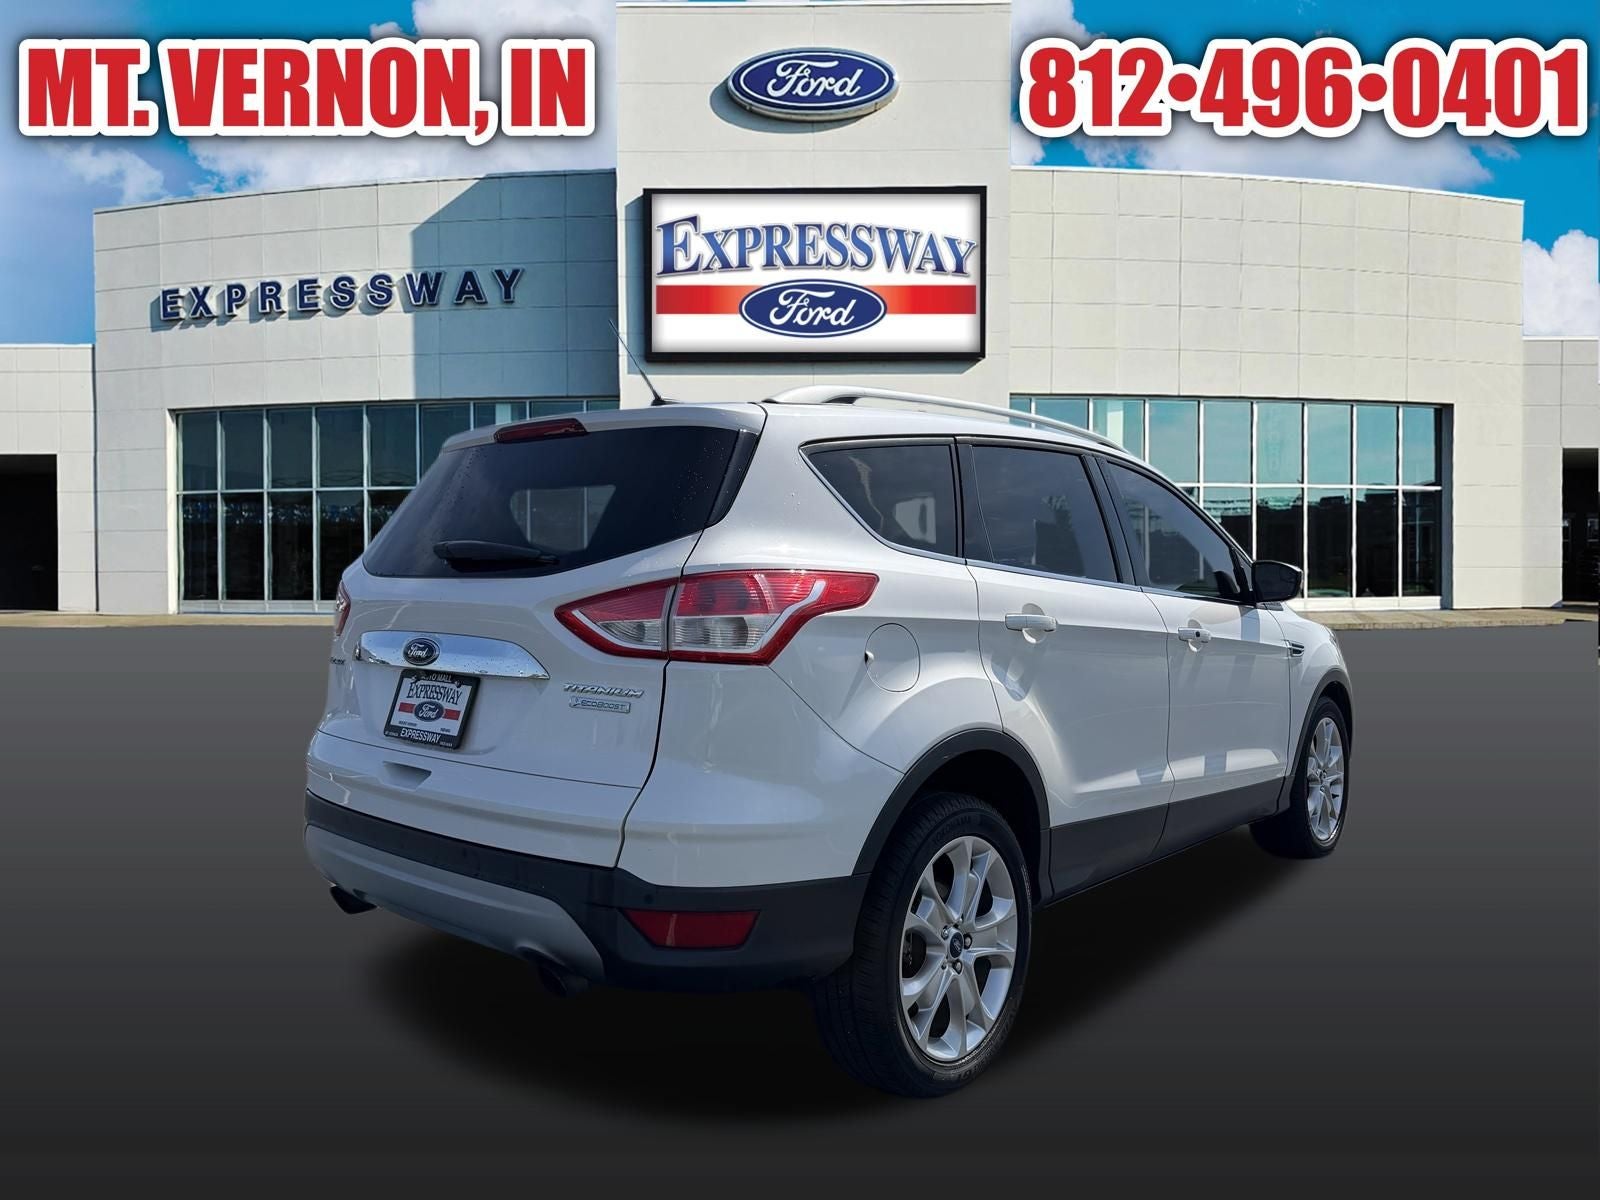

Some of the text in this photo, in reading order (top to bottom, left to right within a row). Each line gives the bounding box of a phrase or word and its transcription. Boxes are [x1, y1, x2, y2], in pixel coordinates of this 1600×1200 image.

[766, 60, 863, 97] Ford
[656, 215, 977, 277] EXPRESSWAY
[160, 267, 525, 321] EXPRESSWAY
[769, 289, 857, 326] Ford
[408, 642, 429, 658] Ford
[406, 684, 463, 705] EXPRESSWAY
[563, 683, 645, 698] TITANIUM
[418, 704, 439, 719] Ford
[400, 728, 441, 743] EXPRESSWAY
